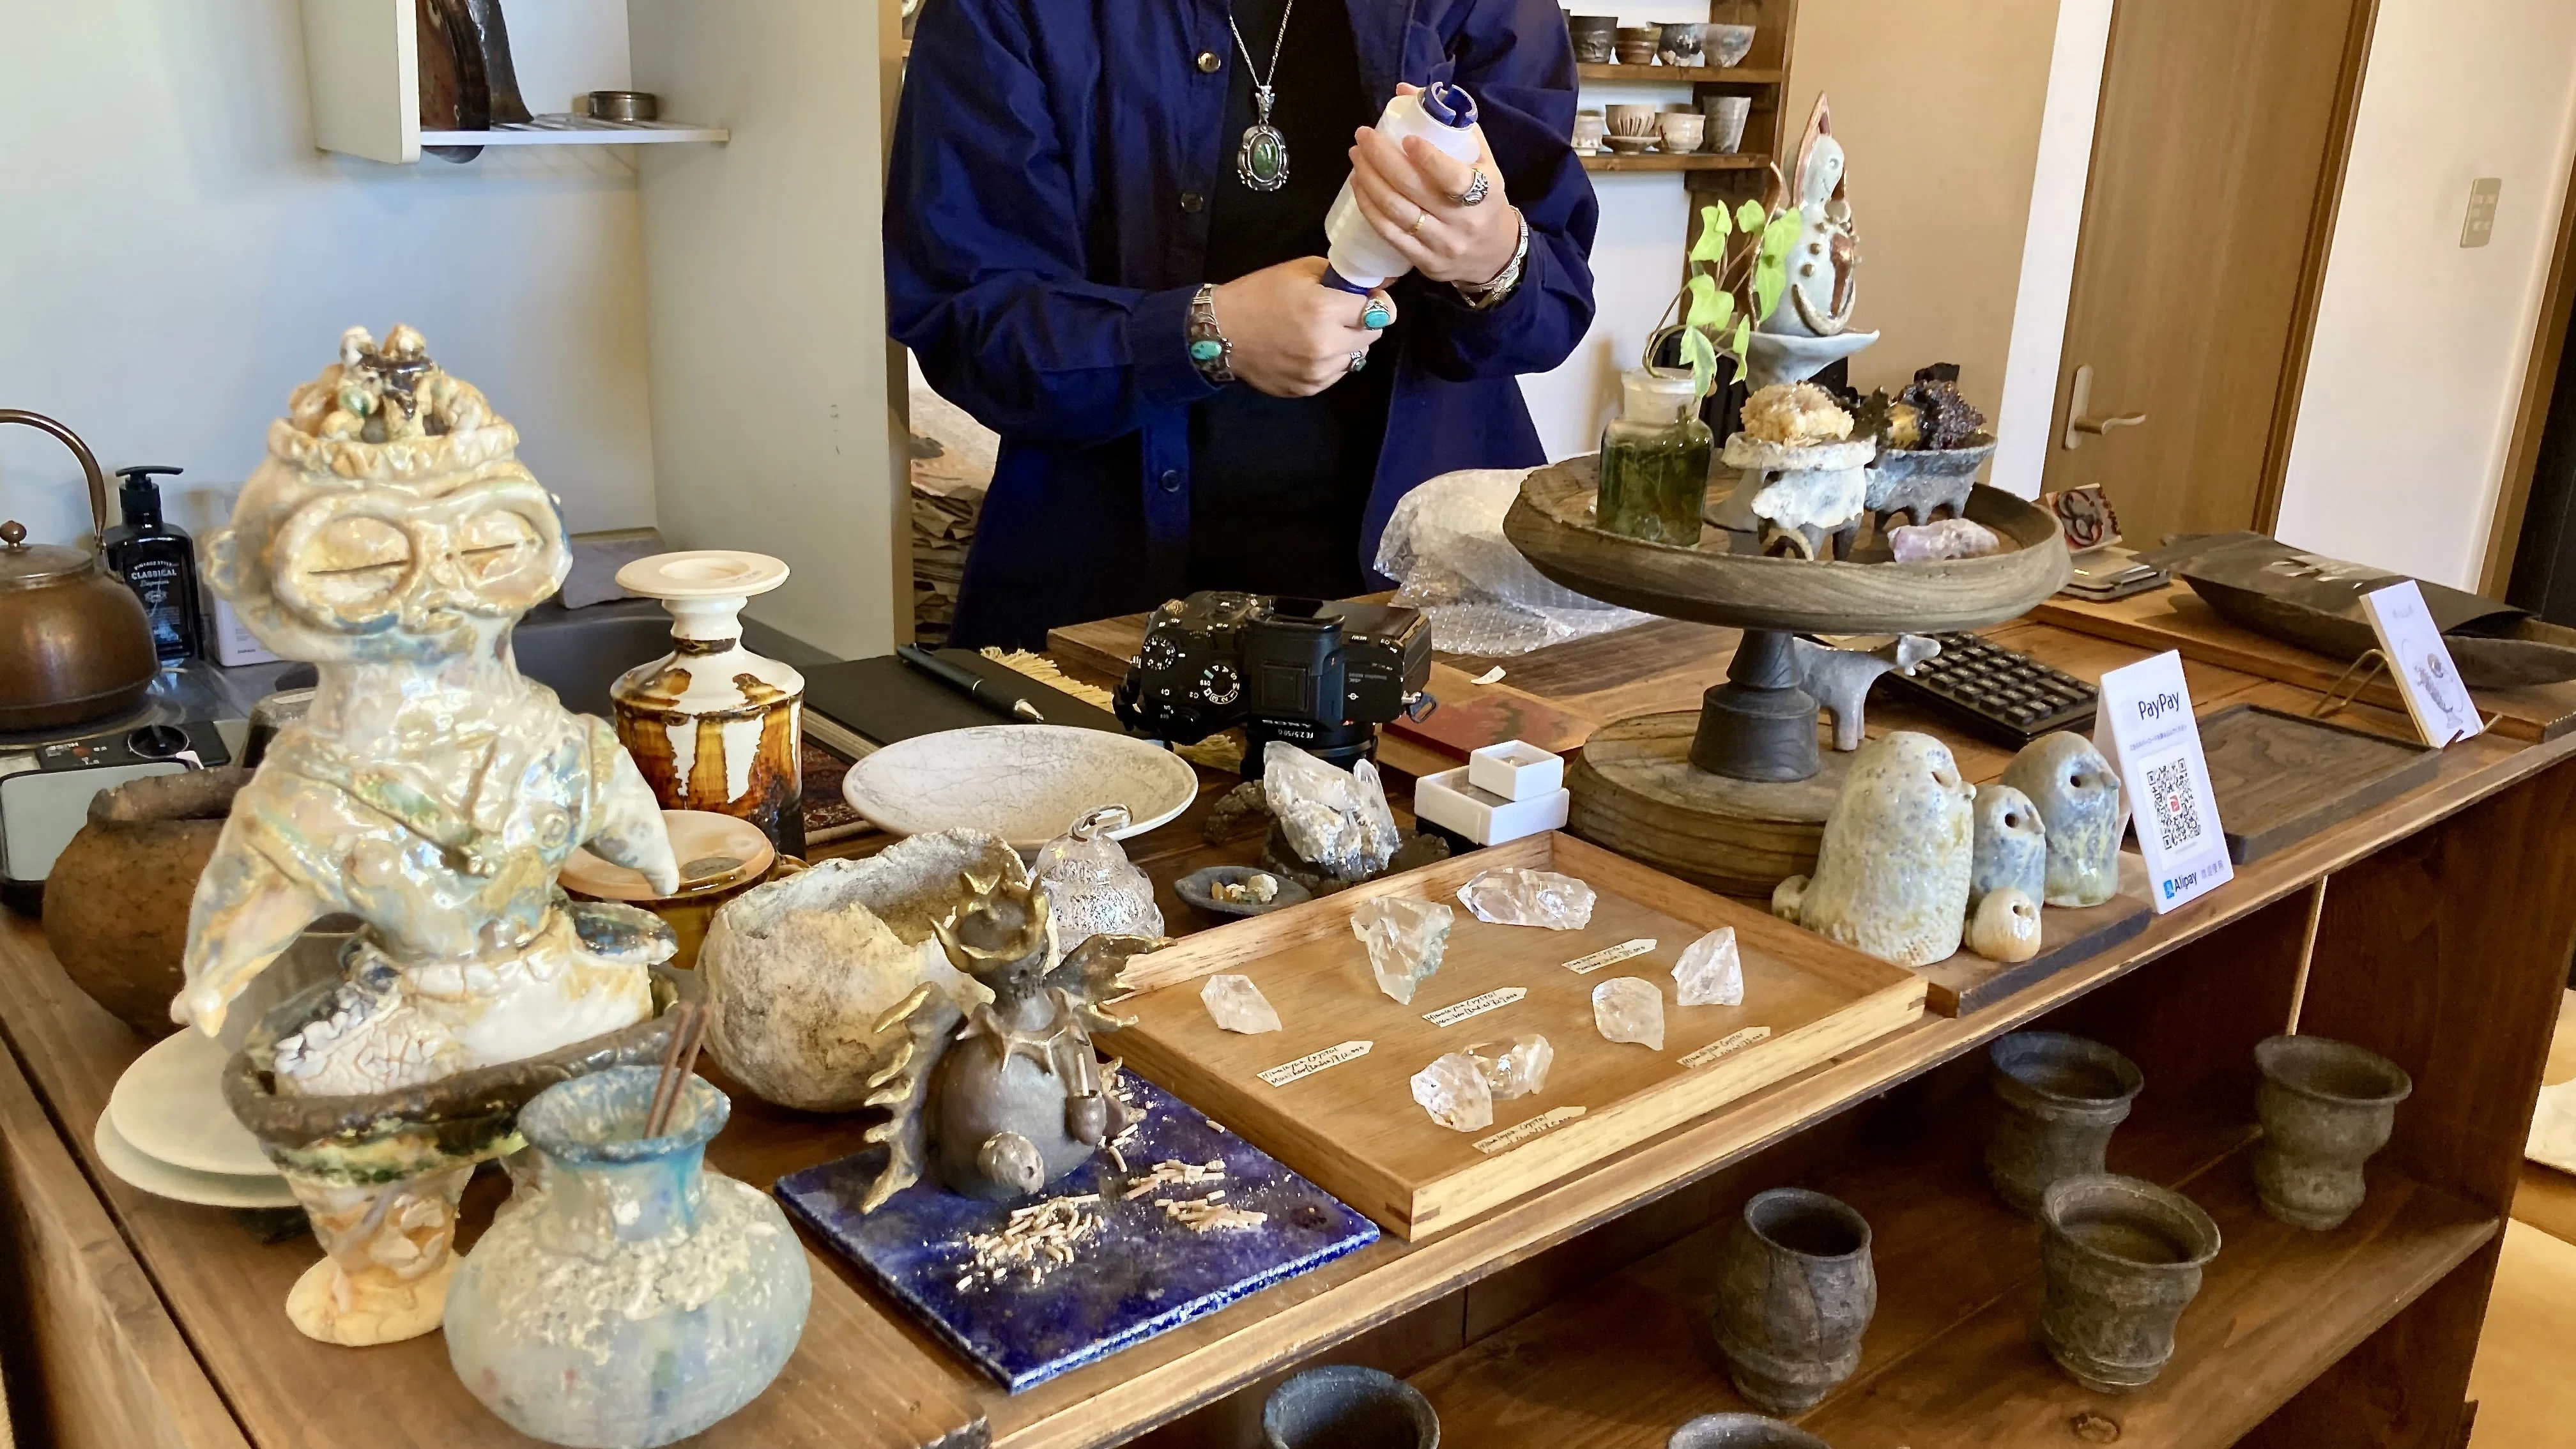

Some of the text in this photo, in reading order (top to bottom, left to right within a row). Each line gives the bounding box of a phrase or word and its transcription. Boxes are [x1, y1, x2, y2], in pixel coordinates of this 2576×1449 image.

[131, 569, 177, 580] CLASSICAL
[2138, 692, 2179, 721] PayPay
[2174, 872, 2197, 892] Alipay
